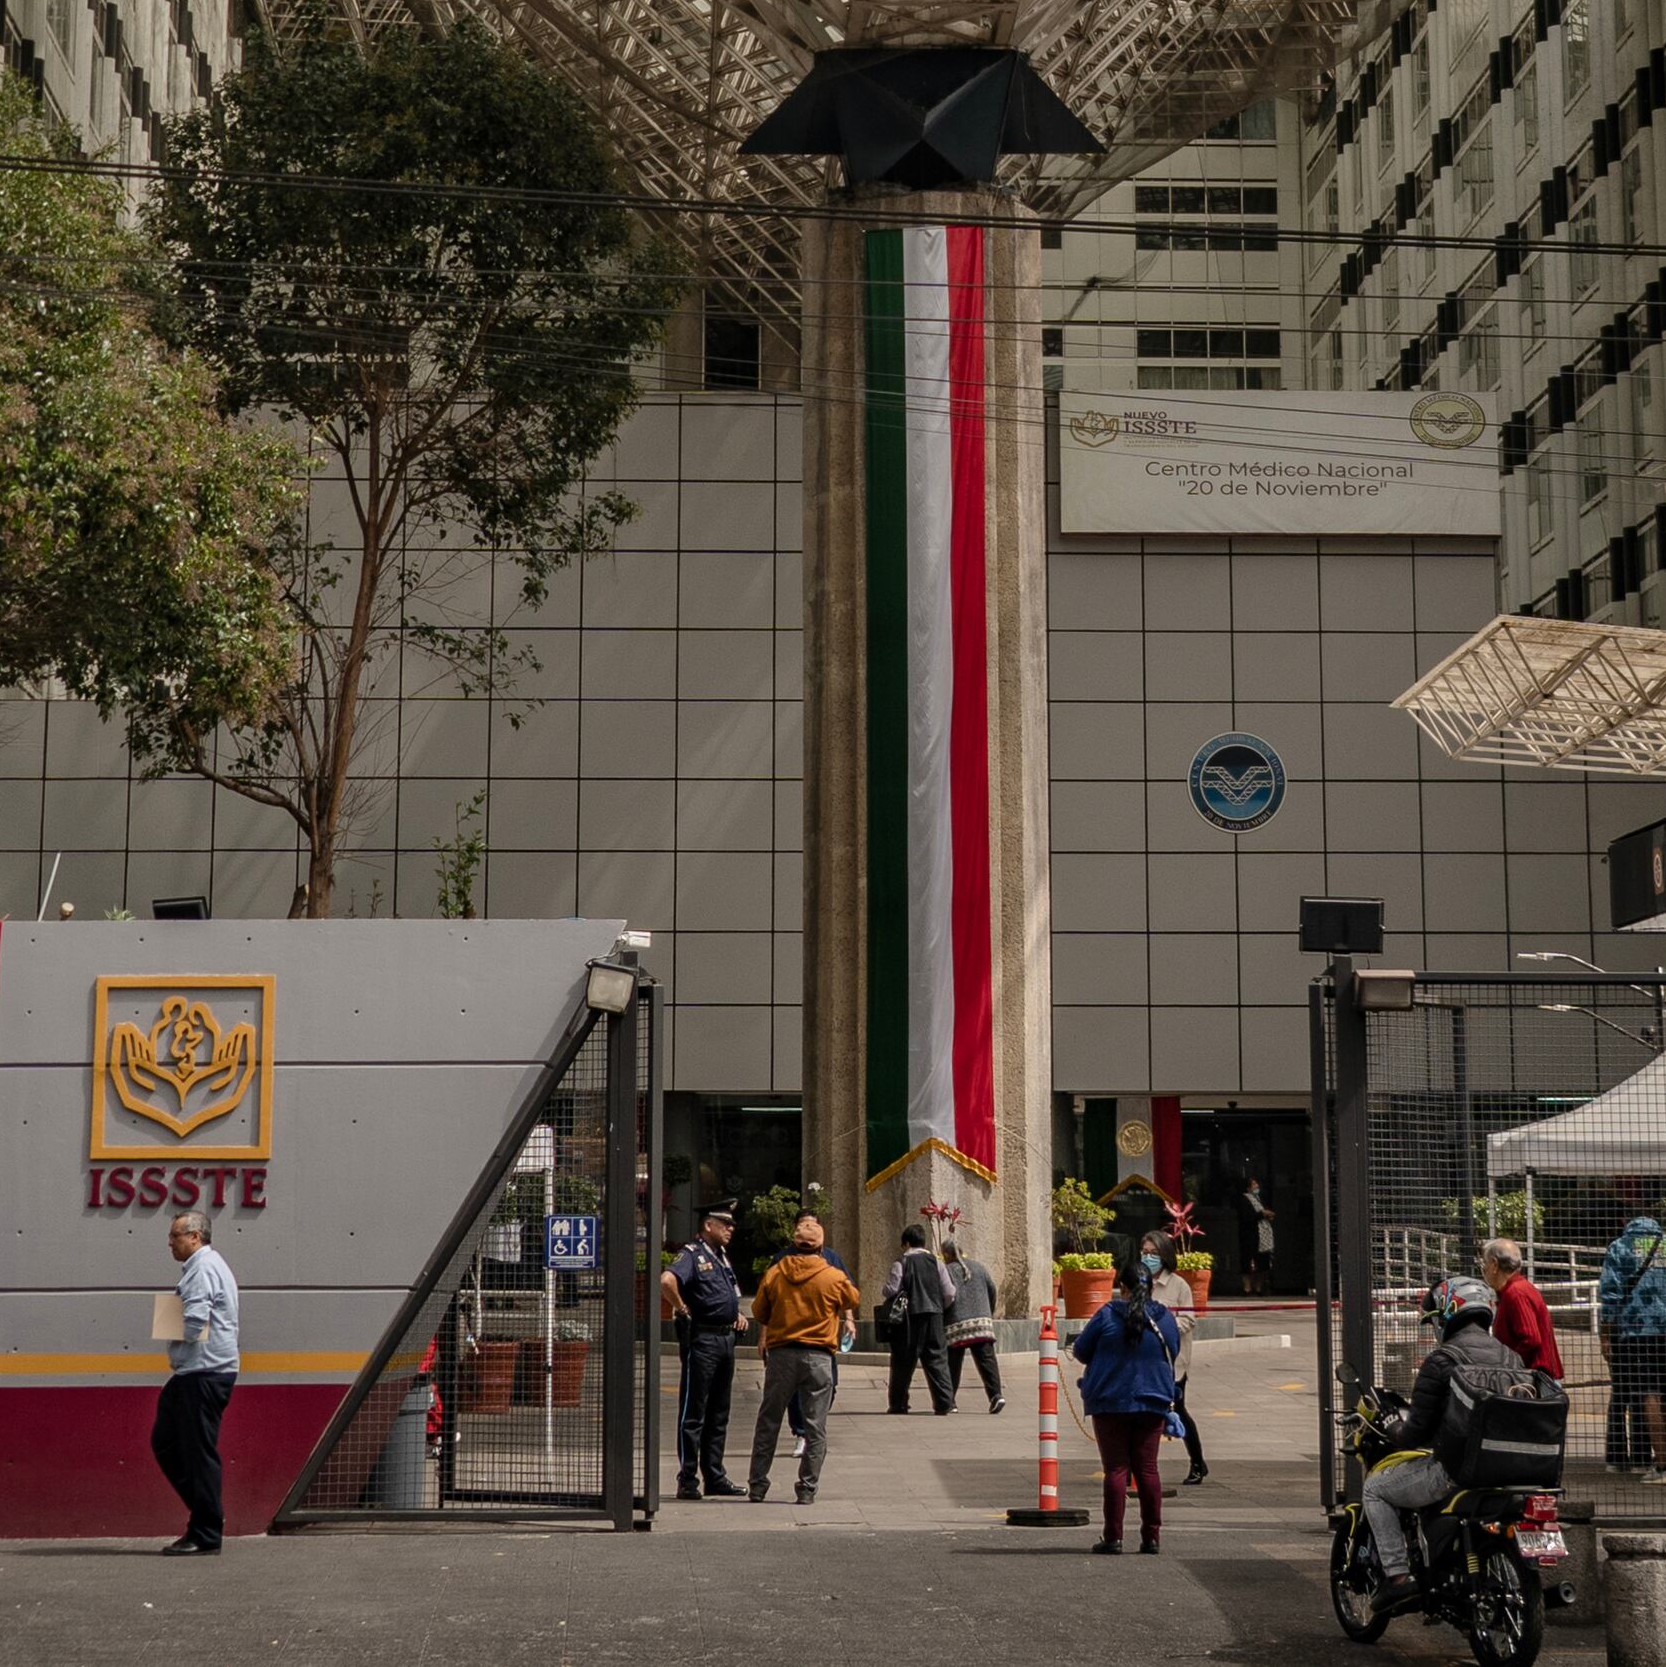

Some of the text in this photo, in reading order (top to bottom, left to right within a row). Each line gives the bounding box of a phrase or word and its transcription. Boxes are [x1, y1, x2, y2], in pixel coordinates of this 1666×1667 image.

[1124, 411, 1167, 419] NUEVO
[1124, 421, 1197, 434] ISSSTE
[1145, 461, 1414, 478] Centro Médico Nacional
[1178, 480, 1387, 497] "20 de Noviembre"
[88, 1166, 267, 1208] ISSSTE
